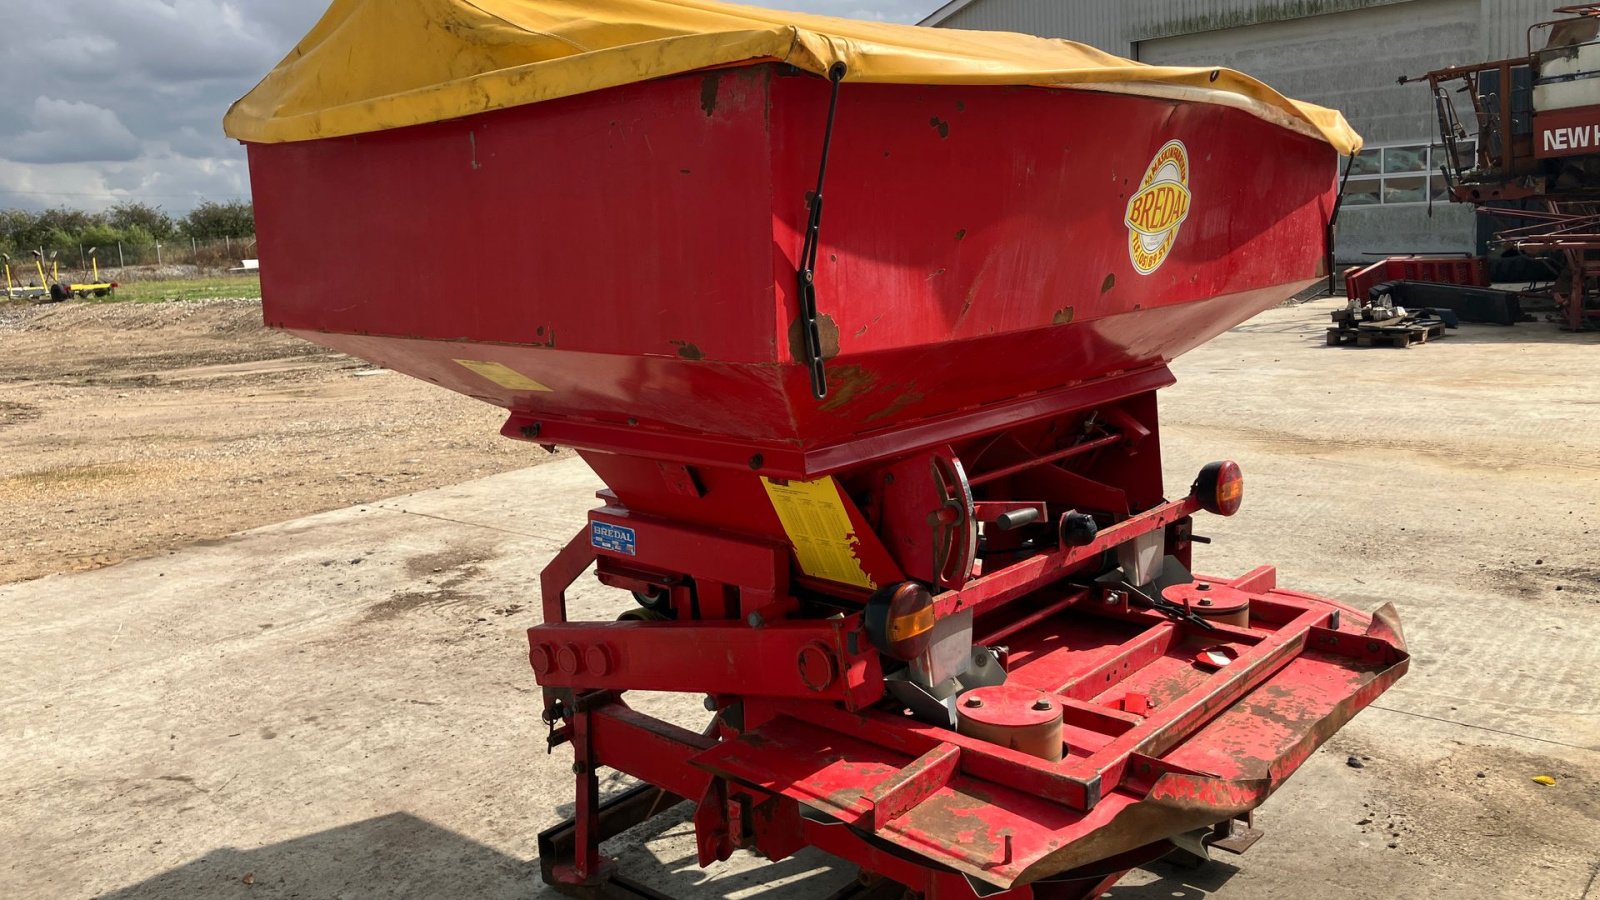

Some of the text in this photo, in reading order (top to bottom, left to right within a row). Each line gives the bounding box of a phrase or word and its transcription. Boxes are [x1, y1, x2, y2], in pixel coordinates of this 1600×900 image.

[1543, 125, 1590, 151] NEW
[1130, 187, 1187, 231] BREDAL
[593, 526, 632, 541] BREDAL
